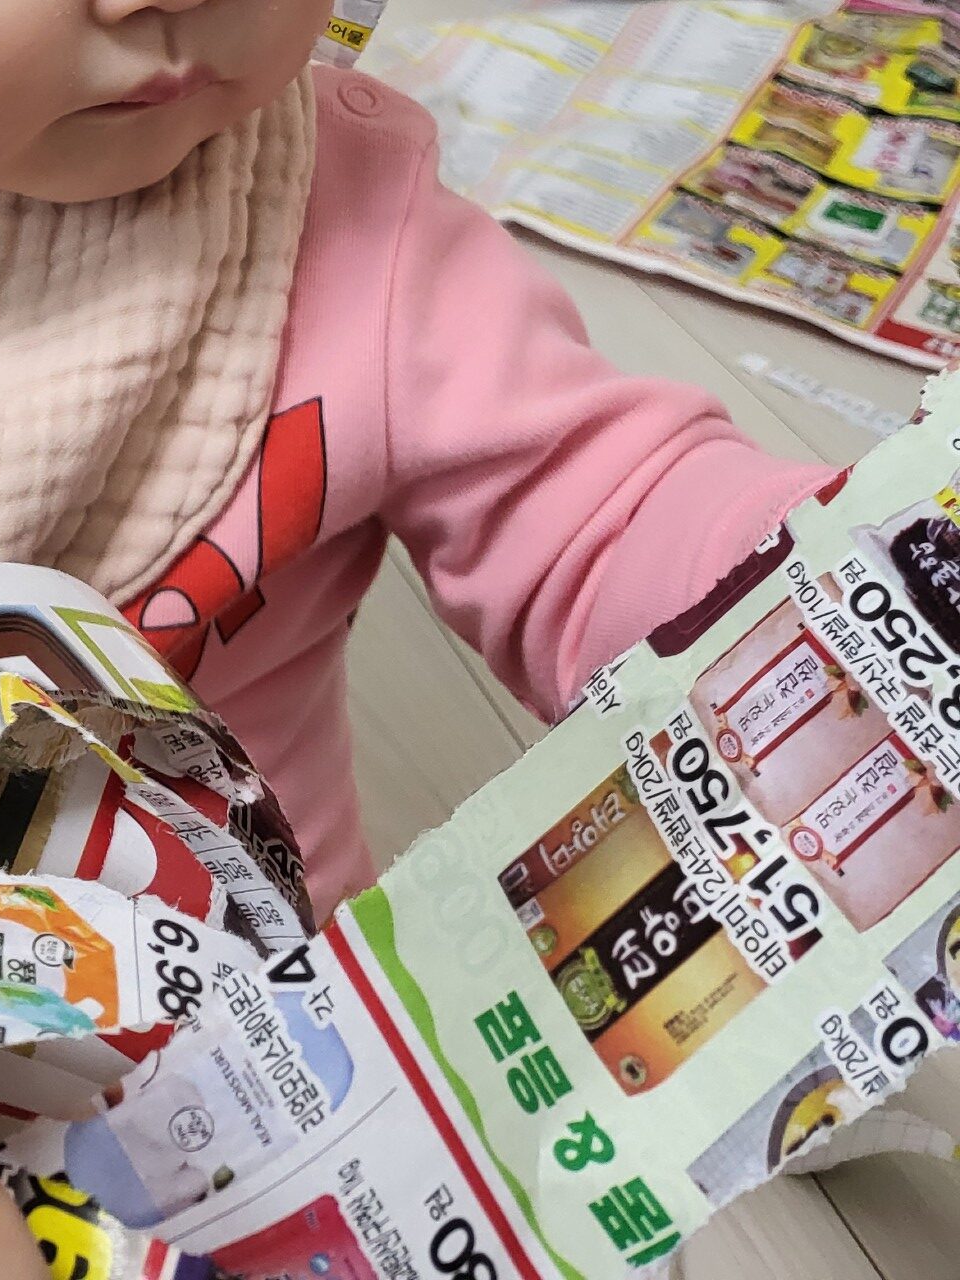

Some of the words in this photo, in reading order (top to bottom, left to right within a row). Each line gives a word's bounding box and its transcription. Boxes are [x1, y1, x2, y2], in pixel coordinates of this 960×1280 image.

[774, 653, 820, 704] 찹쌀
[855, 748, 901, 797] 찹쌀
[711, 890, 785, 980] 태양미
[471, 988, 577, 1118] 음료
[552, 1110, 617, 1175] &
